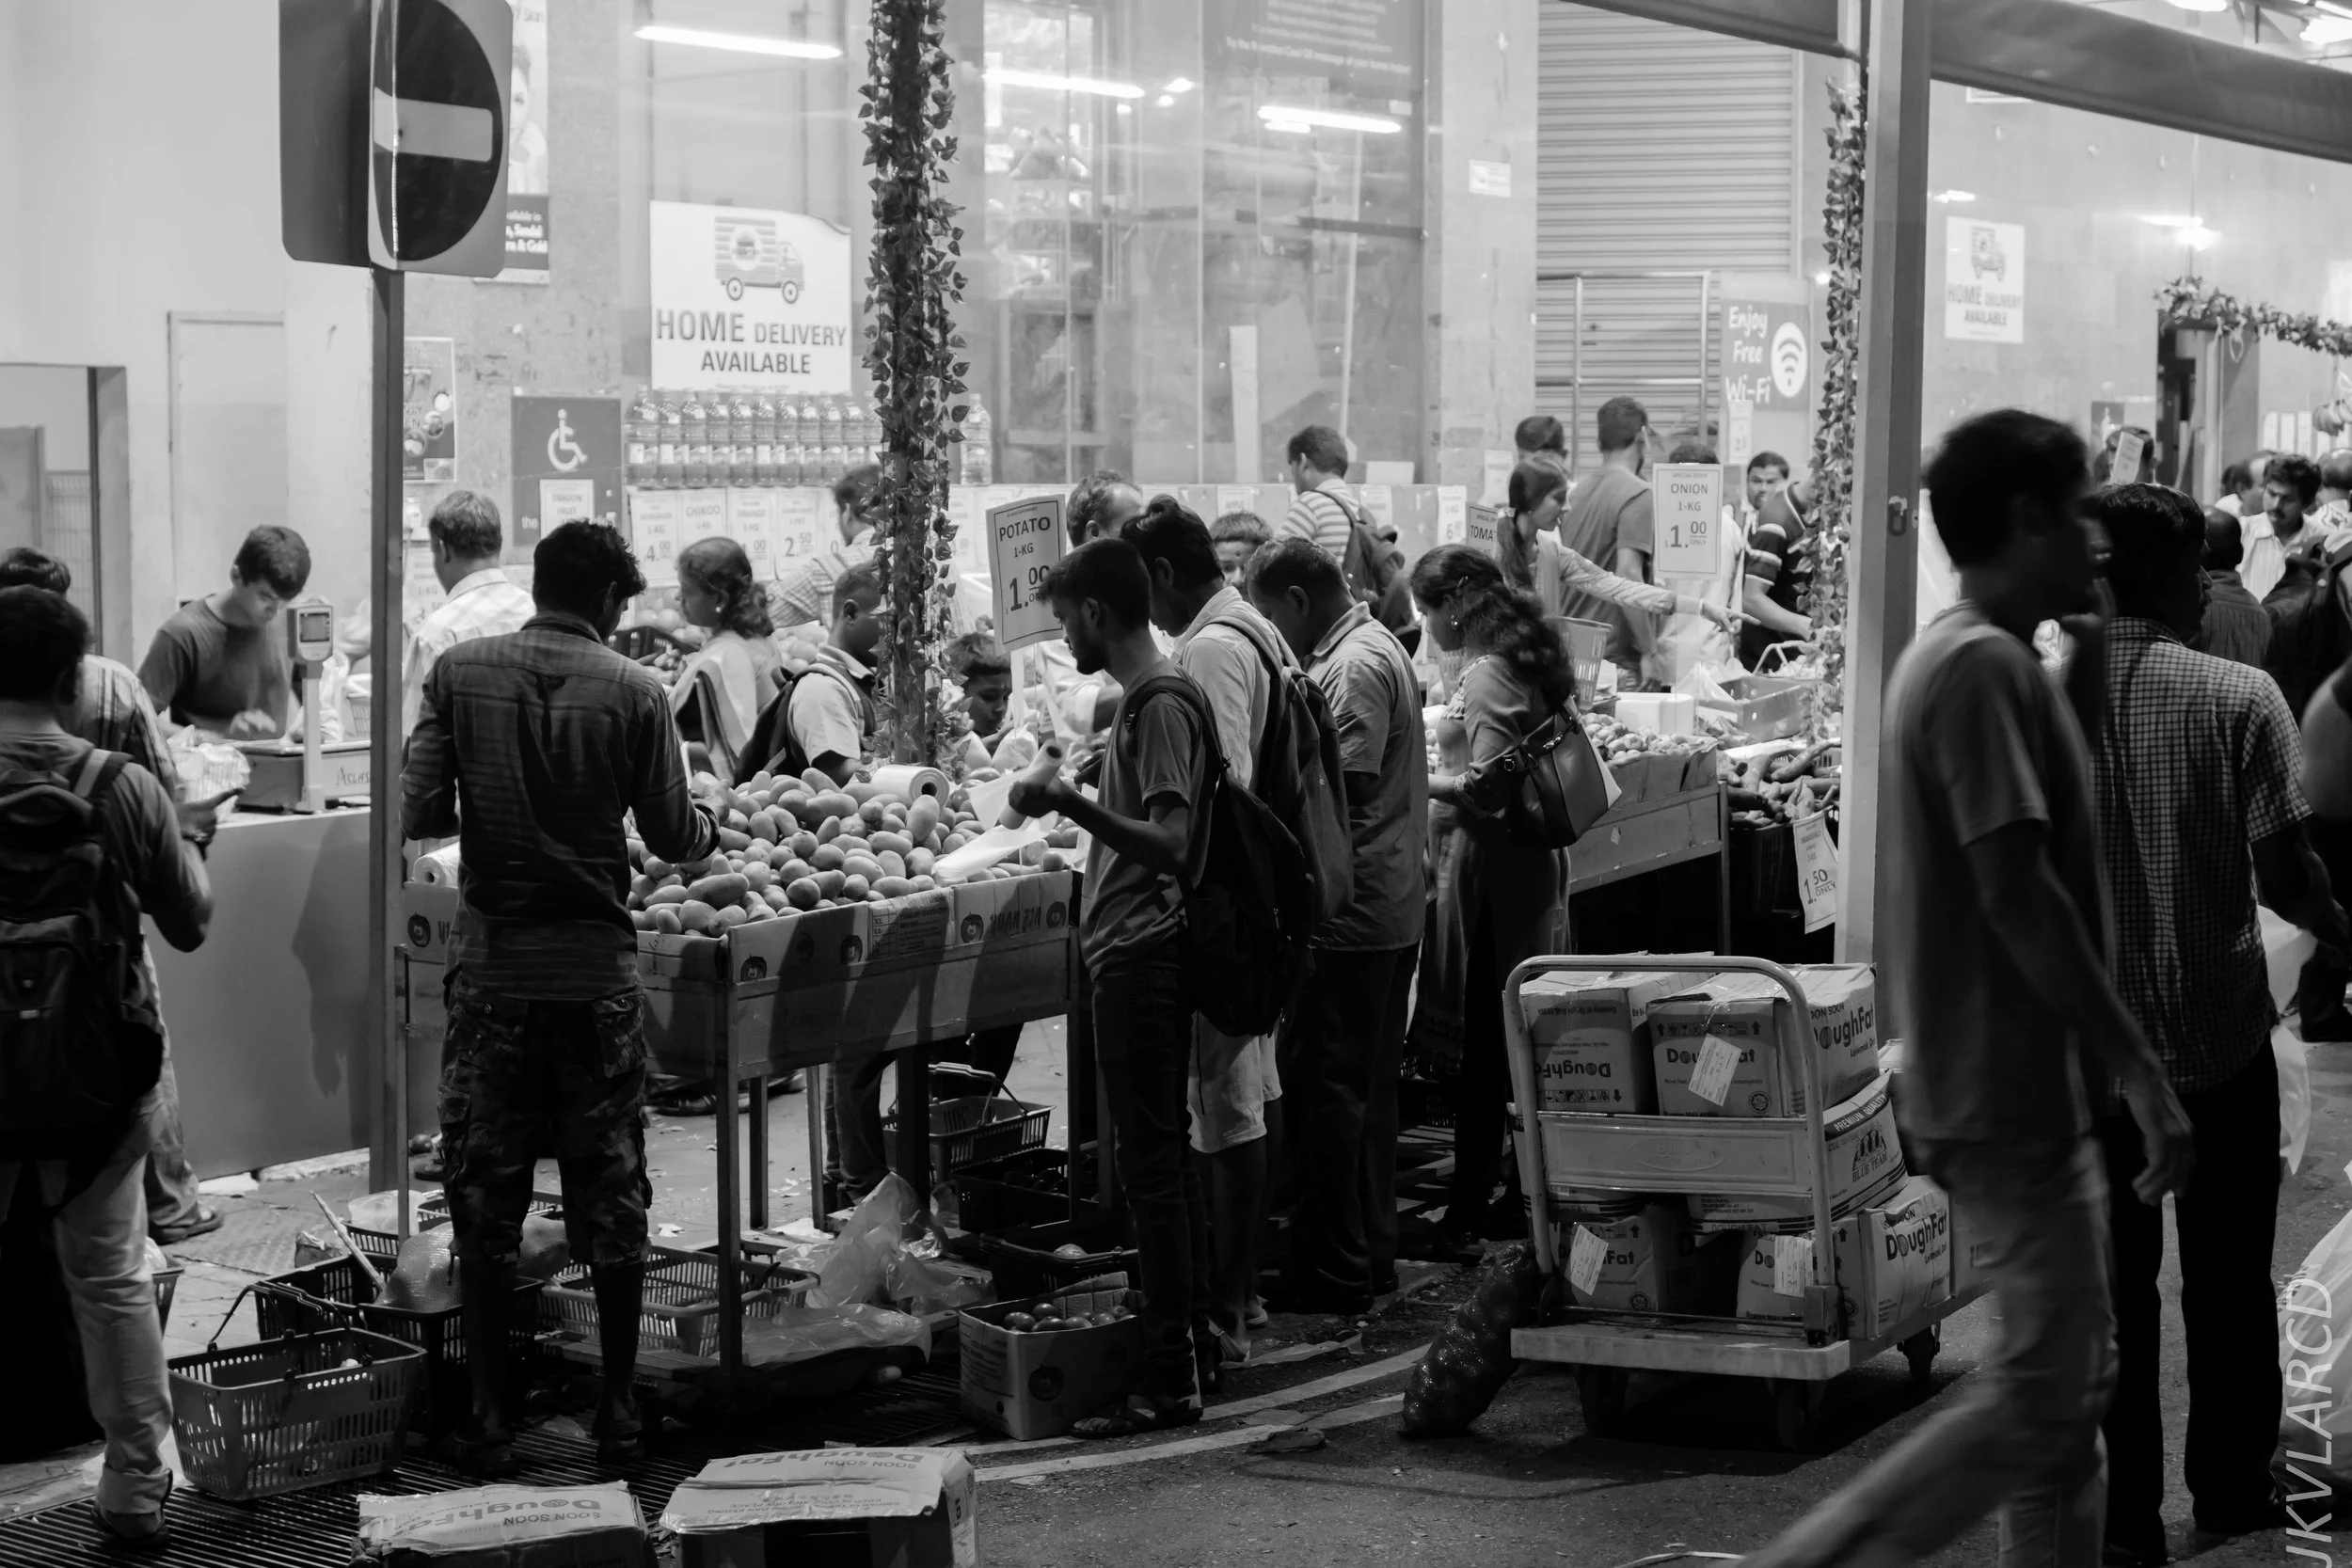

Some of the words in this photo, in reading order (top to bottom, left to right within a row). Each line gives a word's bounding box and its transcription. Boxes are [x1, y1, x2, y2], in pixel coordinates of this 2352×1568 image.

[1947, 283, 1981, 305] HOME
[1985, 292, 2022, 309] DELIVERY
[1729, 304, 1768, 338] Enjoy
[1964, 309, 2007, 325] AVAILABLE
[657, 309, 745, 342] HOME
[755, 323, 847, 346] DELIVERY
[1733, 340, 1763, 364] Free
[701, 350, 811, 373] AVAILABLE
[1725, 375, 1772, 404] Wi-Fi
[1671, 483, 1708, 495] ONION
[686, 505, 721, 516] CHIKOO
[1678, 501, 1701, 512] 1-KG
[999, 516, 1051, 542] POTATO
[1691, 521, 1707, 534] 00
[800, 531, 812, 544] 50
[1013, 543, 1034, 558] 1-KG
[1813, 869, 1828, 885] 50
[1815, 880, 1836, 897] ONLY
[1828, 1002, 1845, 1016] SOON
[1534, 1058, 1612, 1079] DoughFa
[1834, 1111, 1866, 1132] PREMIUM
[1862, 1094, 1887, 1116] QUALITY
[1852, 1164, 1870, 1183] BLUE
[1871, 1151, 1887, 1172] TEAM
[1884, 1210, 1947, 1261] DoughFat
[723, 1449, 924, 1468] DoughFat
[824, 1460, 870, 1468] SOON
[503, 1513, 549, 1527] SOON
[555, 1512, 601, 1521] SOON
